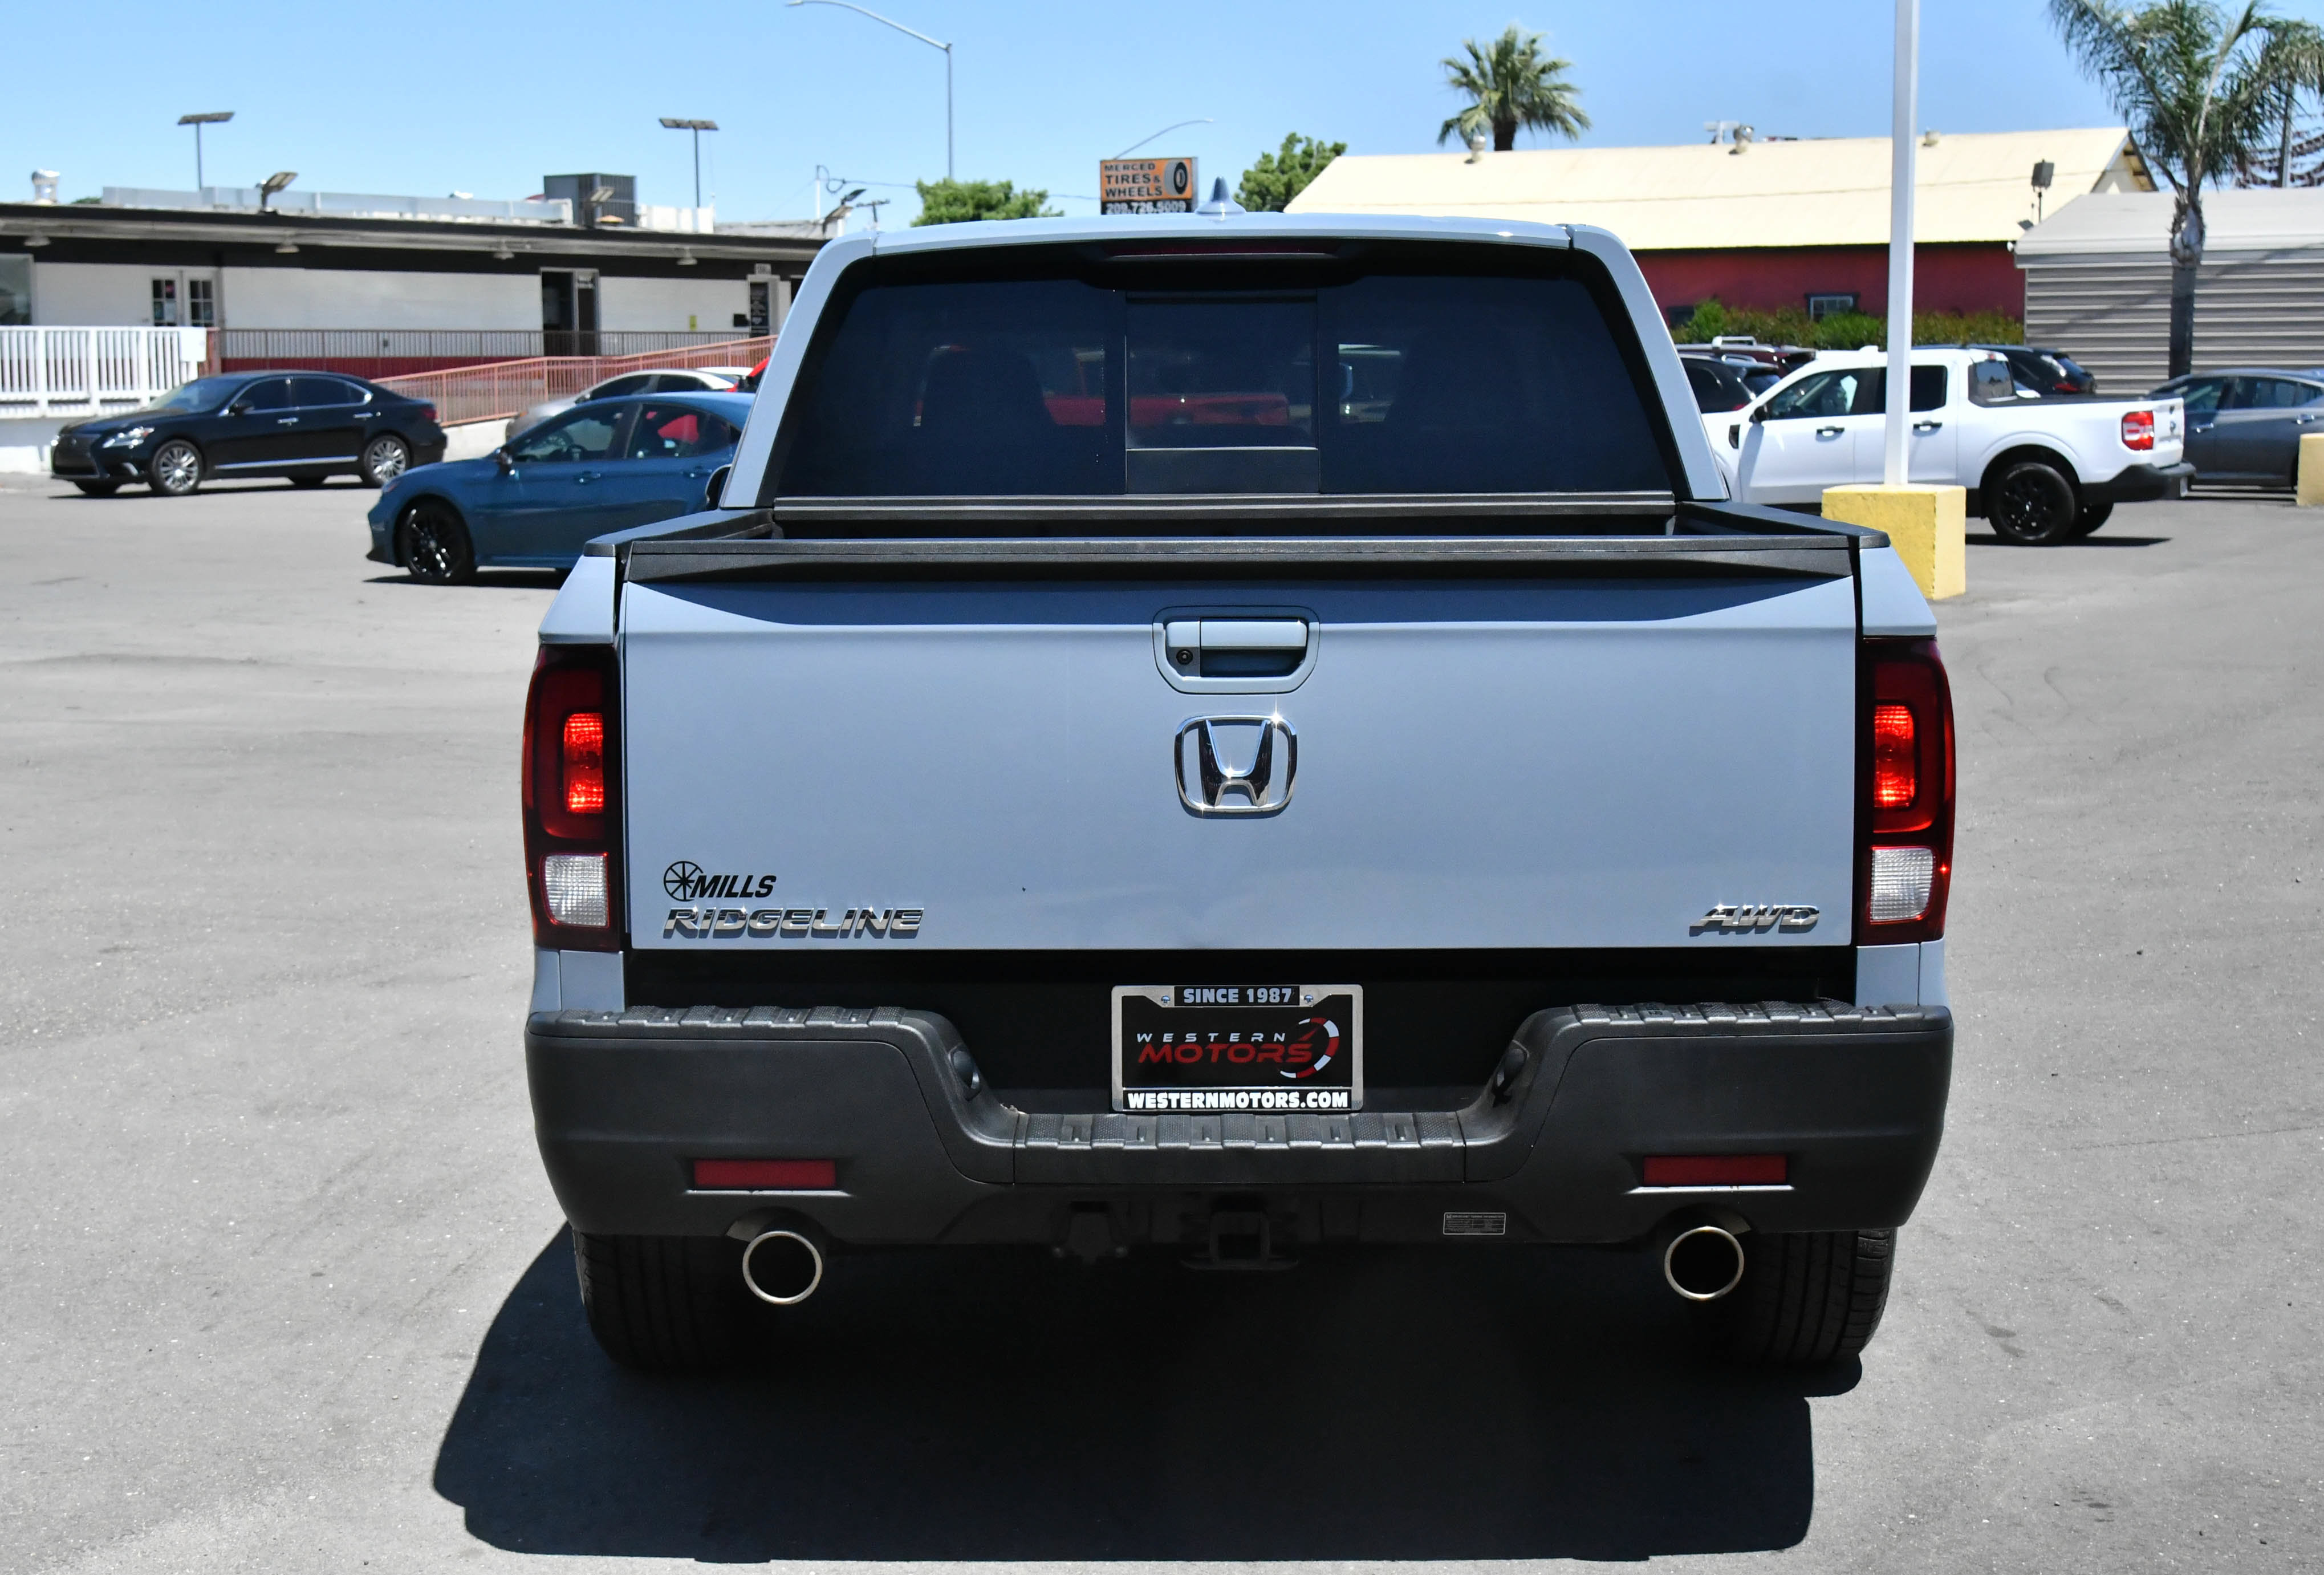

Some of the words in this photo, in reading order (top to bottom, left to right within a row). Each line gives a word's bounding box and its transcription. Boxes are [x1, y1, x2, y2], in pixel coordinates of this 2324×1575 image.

[1105, 173, 1151, 184] TIRES
[1153, 174, 1161, 183] &
[1106, 186, 1163, 197] WHEELS
[689, 875, 777, 898] MILLS
[664, 908, 924, 933] RIDGELINE
[1689, 905, 1820, 931] AWD
[1183, 988, 1239, 1004] SINCE
[1247, 988, 1293, 1004] 1987
[1136, 1032, 1286, 1043] WESTERN
[1137, 1043, 1313, 1063] MOTORS
[1127, 1091, 1348, 1109] WESTERNMOTORS.COM
